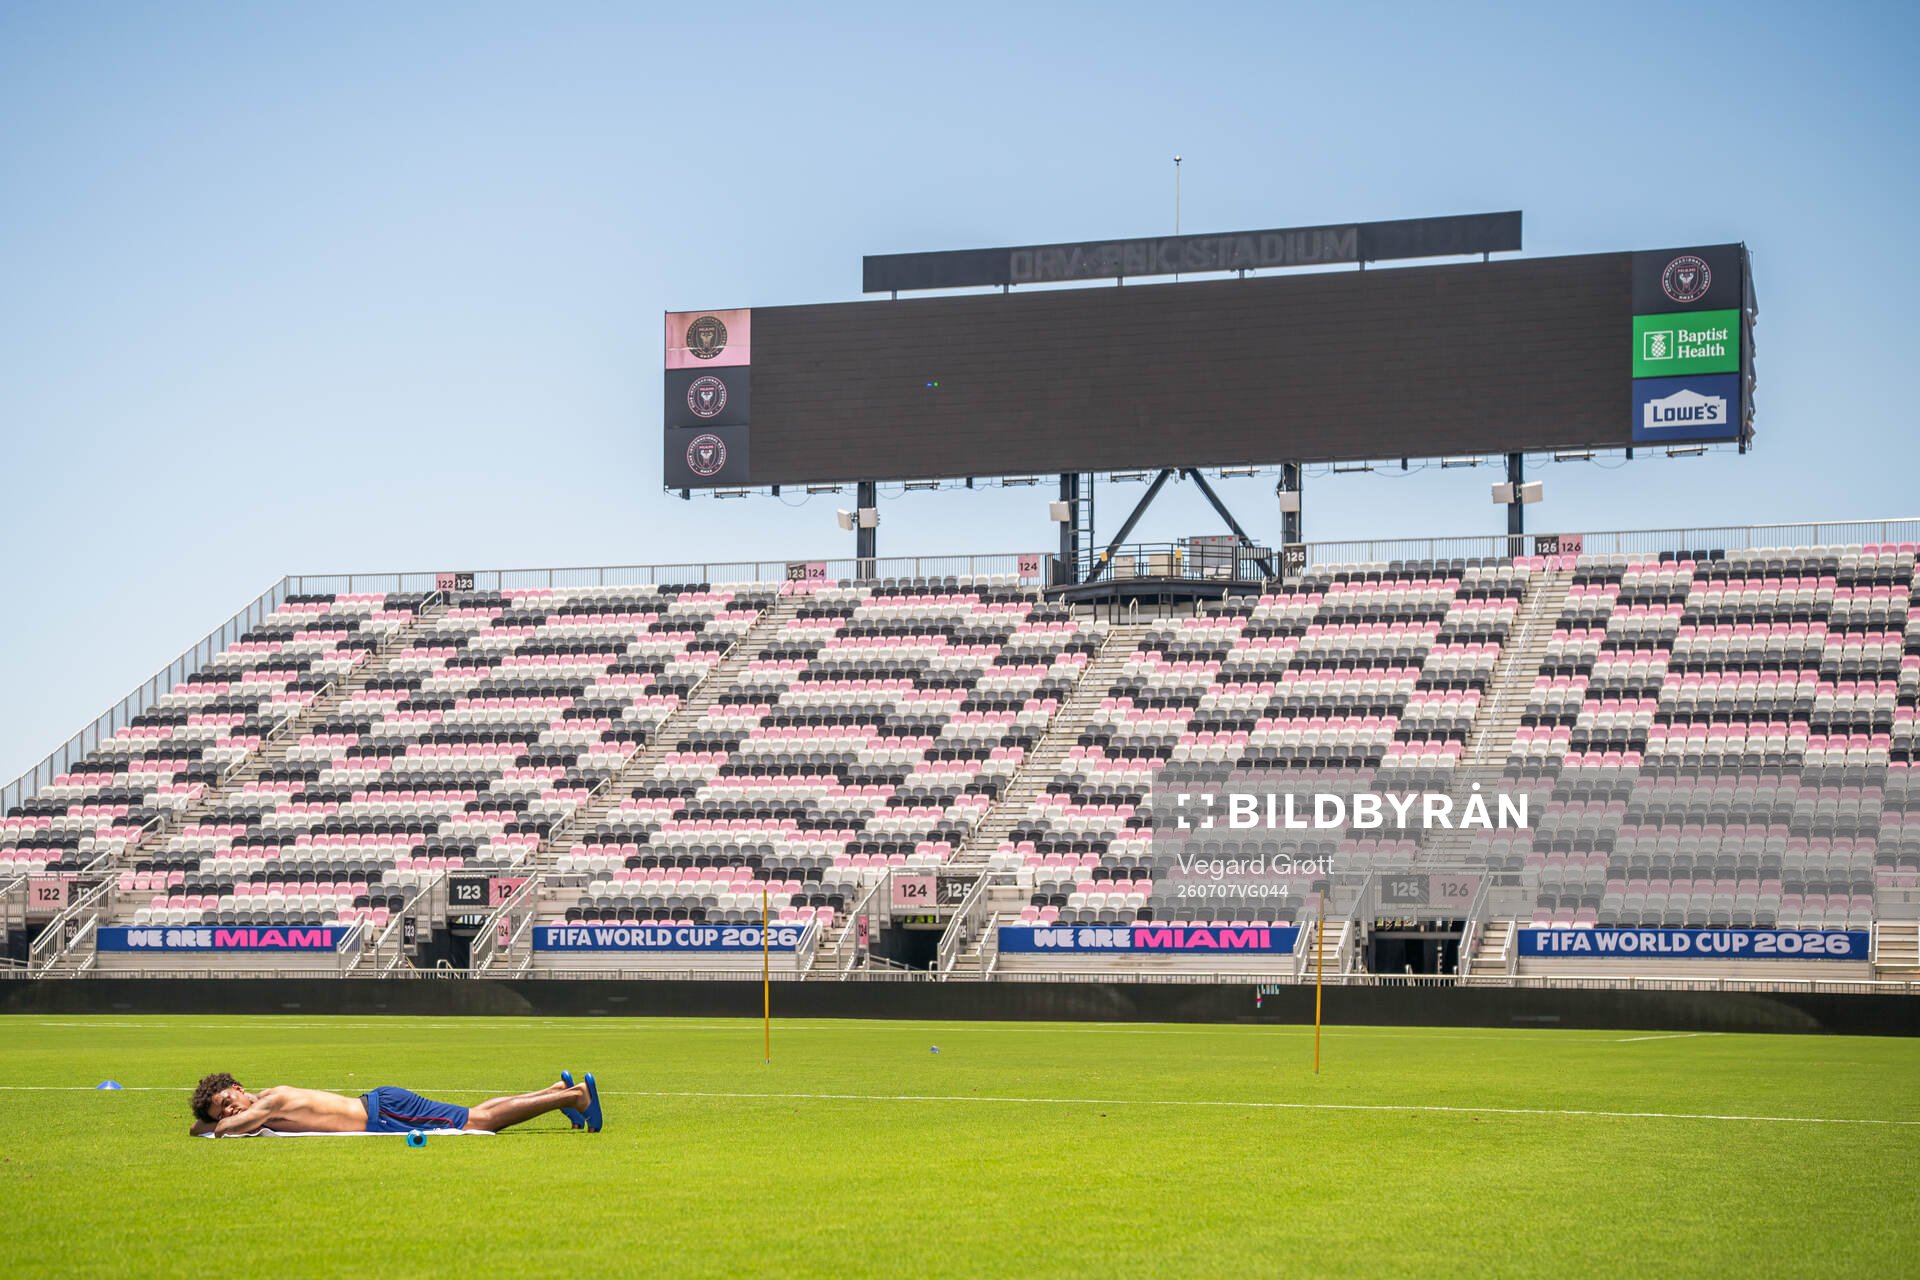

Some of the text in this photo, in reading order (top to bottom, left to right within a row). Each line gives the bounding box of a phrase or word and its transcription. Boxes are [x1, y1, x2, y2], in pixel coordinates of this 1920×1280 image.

[1678, 328, 1728, 345] Baptist
[1678, 343, 1725, 359] Health
[1653, 403, 1719, 423] LOWE'S
[1537, 542, 1557, 553] 125
[1562, 542, 1581, 552] 126
[1286, 552, 1305, 562] 125
[808, 569, 825, 577] 124
[1020, 562, 1037, 571] 124
[788, 569, 805, 578] 123
[438, 580, 453, 588] 122
[457, 579, 473, 588] 123
[38, 888, 60, 900] 122
[456, 885, 481, 899] 123
[902, 884, 928, 897] 124
[946, 883, 971, 897] 125
[1391, 882, 1419, 896] 125
[1441, 883, 1468, 897] 126
[404, 925, 414, 936] 123
[498, 926, 508, 937] 124
[547, 928, 798, 946] FIFA WORLD CUP 2026
[127, 929, 163, 947] WE
[215, 929, 333, 947] MIAMI
[1034, 929, 1075, 947] WE
[1134, 929, 1271, 948] MIAMI
[1536, 932, 1851, 954] FIFA WORLD CUP 2026
